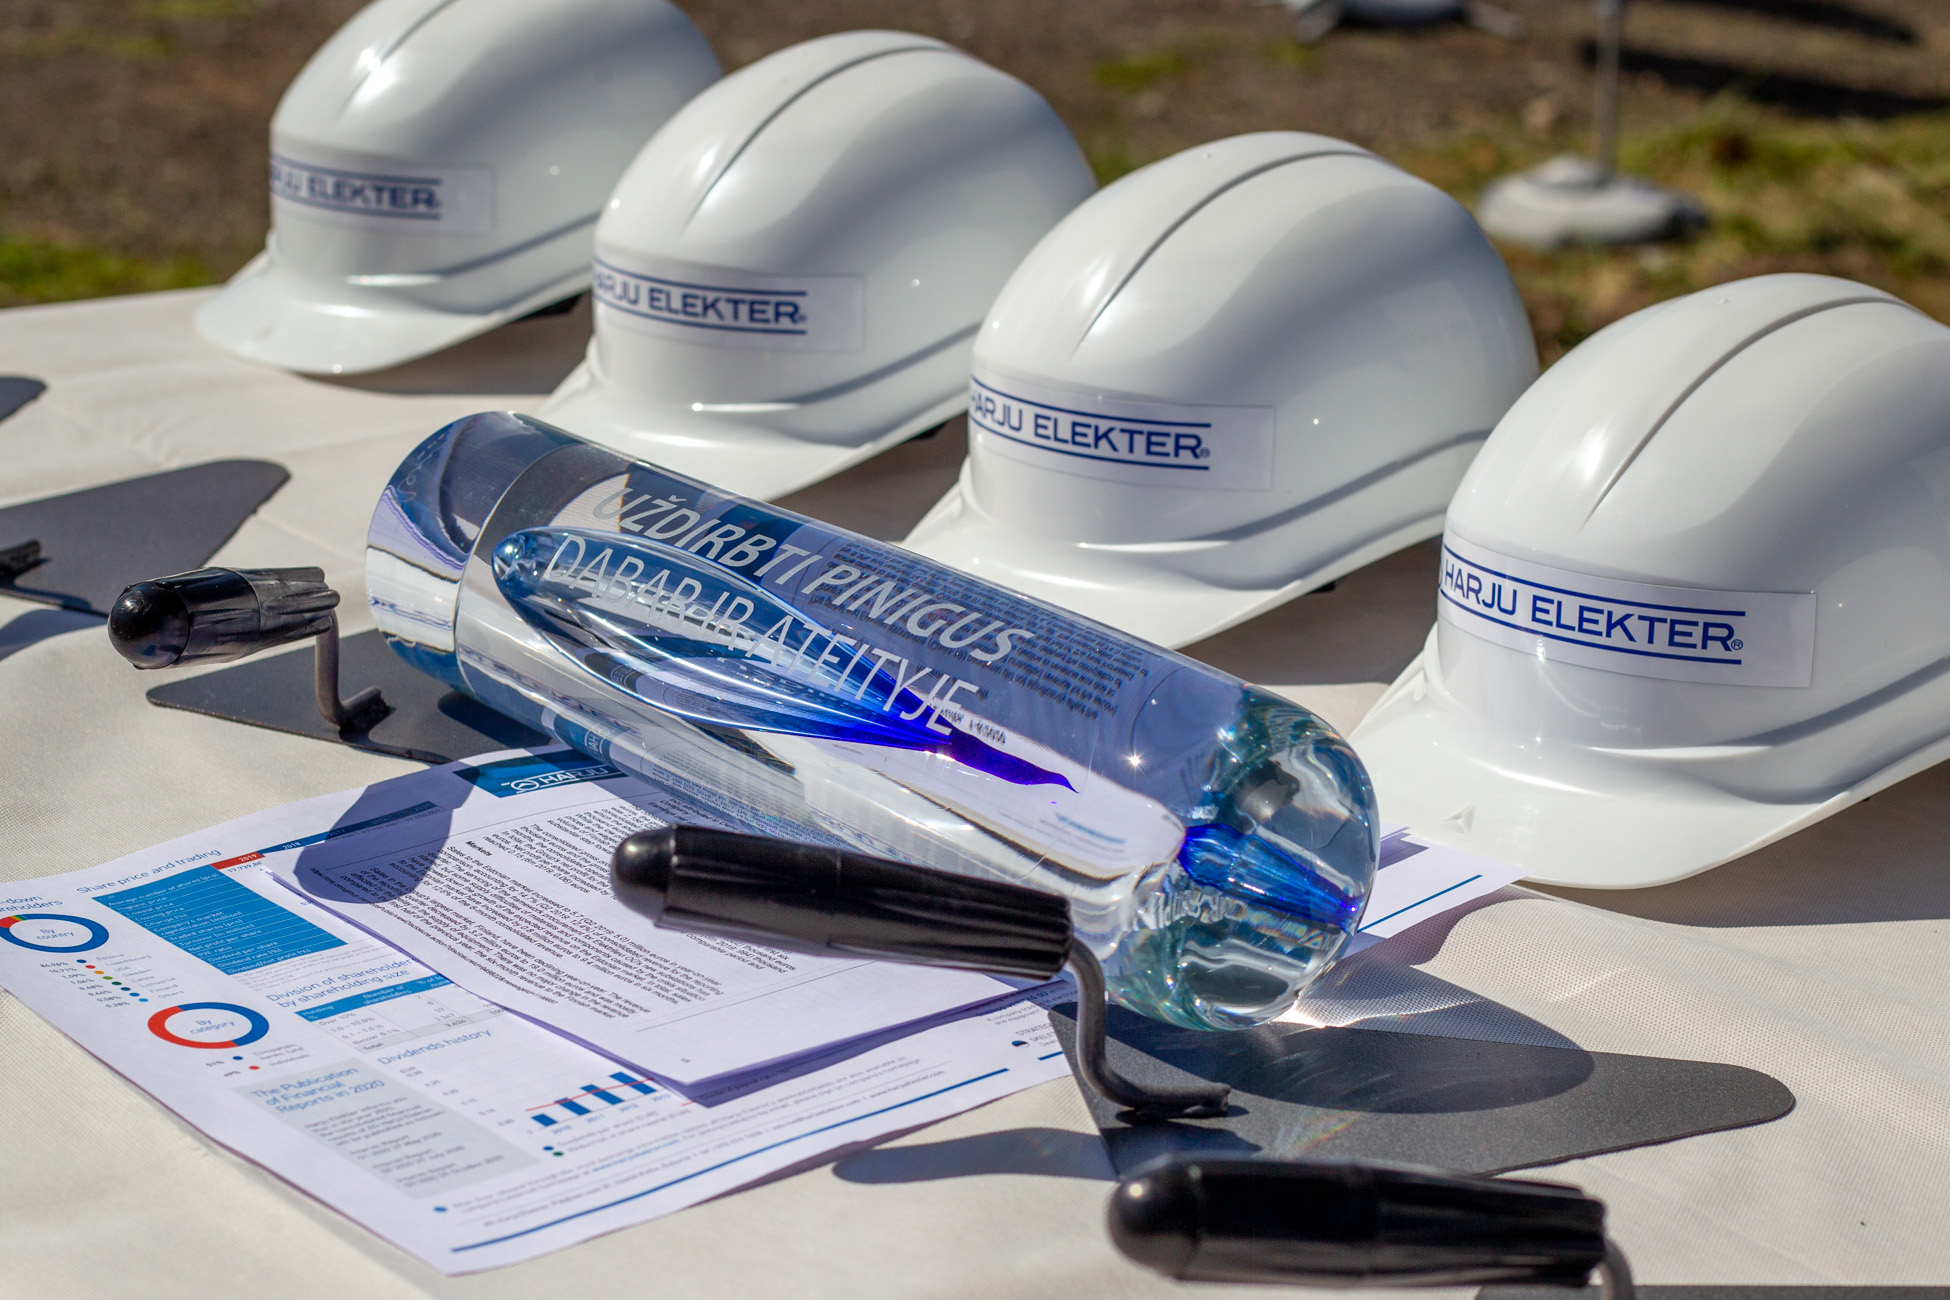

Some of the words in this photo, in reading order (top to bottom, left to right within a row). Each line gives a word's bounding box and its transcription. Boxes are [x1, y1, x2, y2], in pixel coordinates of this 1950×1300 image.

[593, 487, 823, 585] UŽDIRBTI
[801, 565, 1035, 662] PINIGUS
[1445, 558, 1518, 616] HARJU
[543, 534, 702, 627] DABAR
[699, 591, 754, 650] IR
[745, 615, 980, 736] ATEITYJE
[466, 841, 492, 856] Markets
[77, 881, 115, 894] Share
[118, 871, 150, 887] price
[151, 862, 177, 875] and
[175, 849, 222, 866] trading
[482, 865, 510, 880] Estonian
[36, 930, 75, 941] country
[266, 981, 321, 1002] Division
[321, 977, 336, 989] of
[277, 998, 298, 1009] by
[299, 977, 384, 1004] shareholding
[383, 969, 410, 983] size
[190, 1019, 236, 1035] category
[377, 1041, 445, 1066] Dividends
[445, 1029, 492, 1048] history
[280, 1067, 360, 1093] Publication
[281, 1080, 346, 1103] Financial
[276, 1094, 336, 1114] Reports
[349, 1079, 386, 1094] 2020
